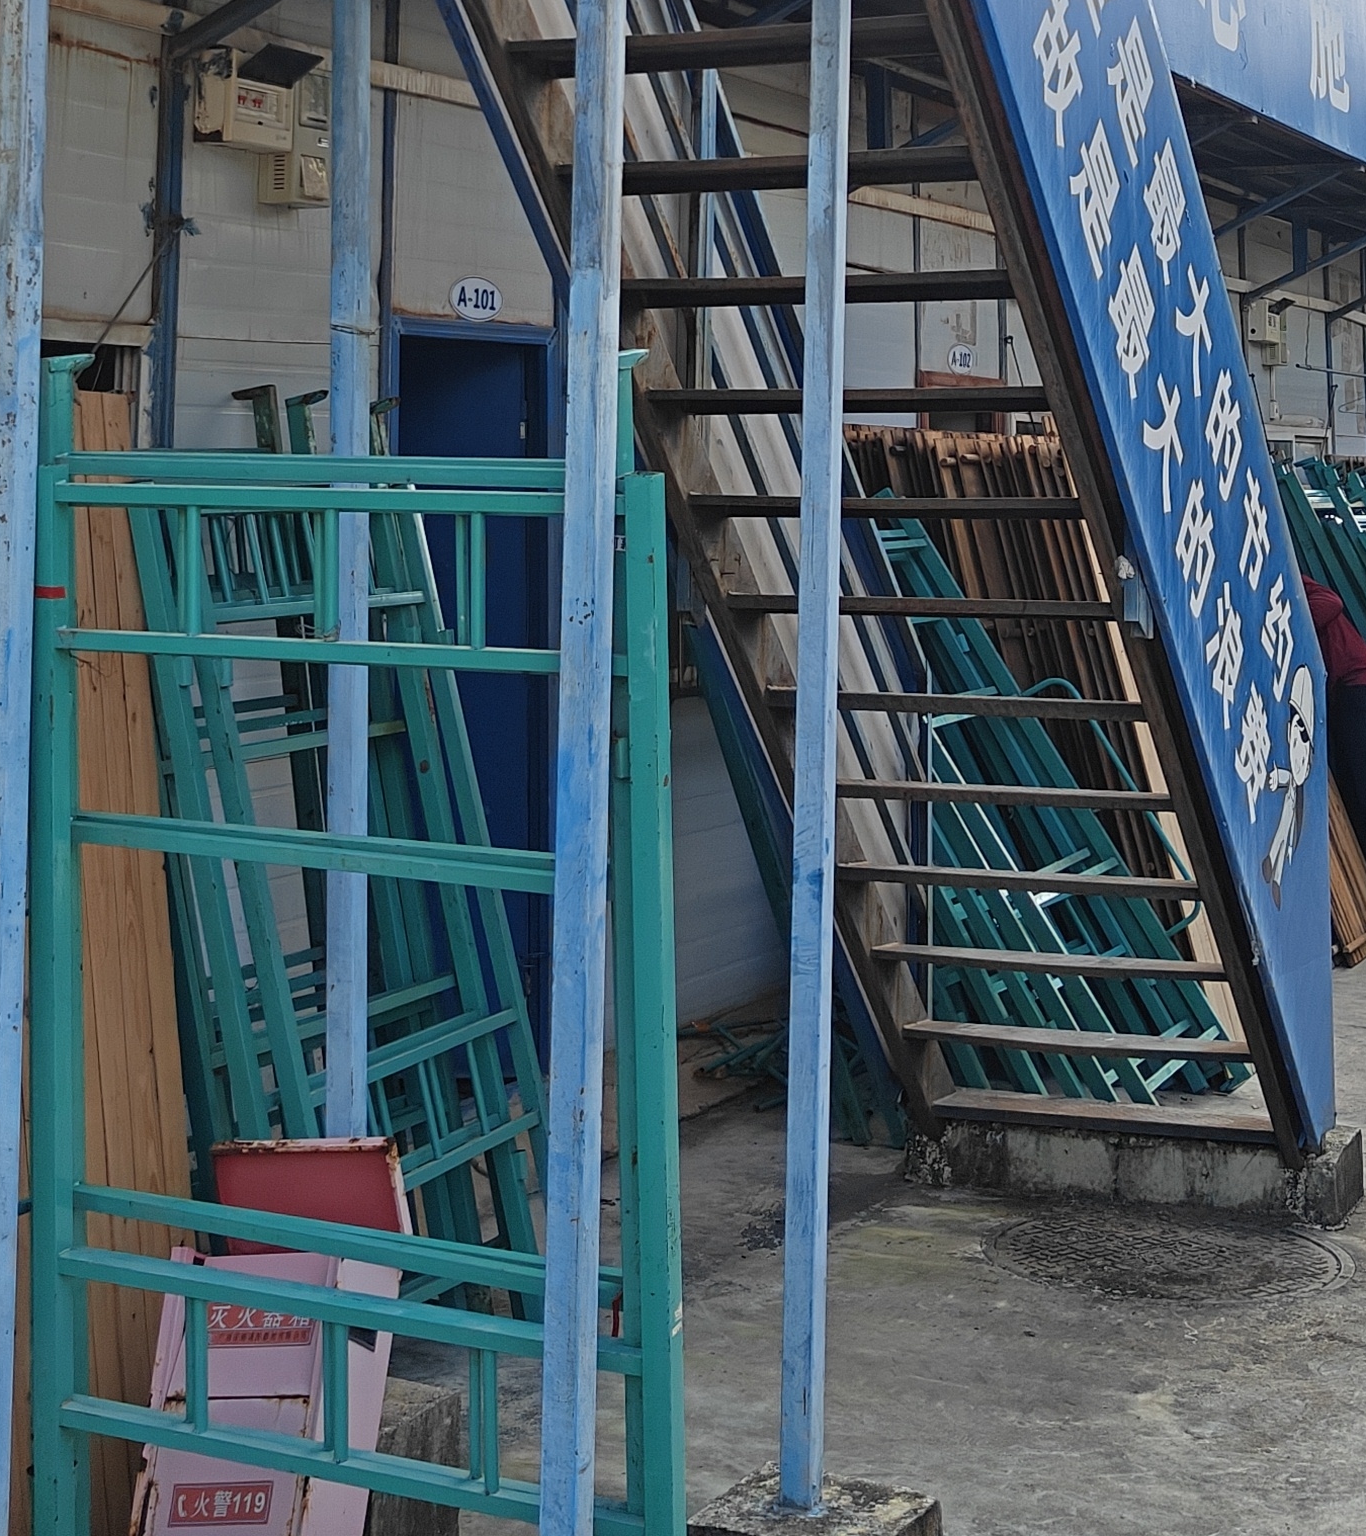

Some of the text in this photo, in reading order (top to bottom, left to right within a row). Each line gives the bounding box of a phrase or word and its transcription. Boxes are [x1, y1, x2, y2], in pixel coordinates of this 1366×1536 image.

[457, 285, 496, 311] A-101
[951, 350, 971, 368] A-102
[190, 1490, 266, 1518] 火警119
